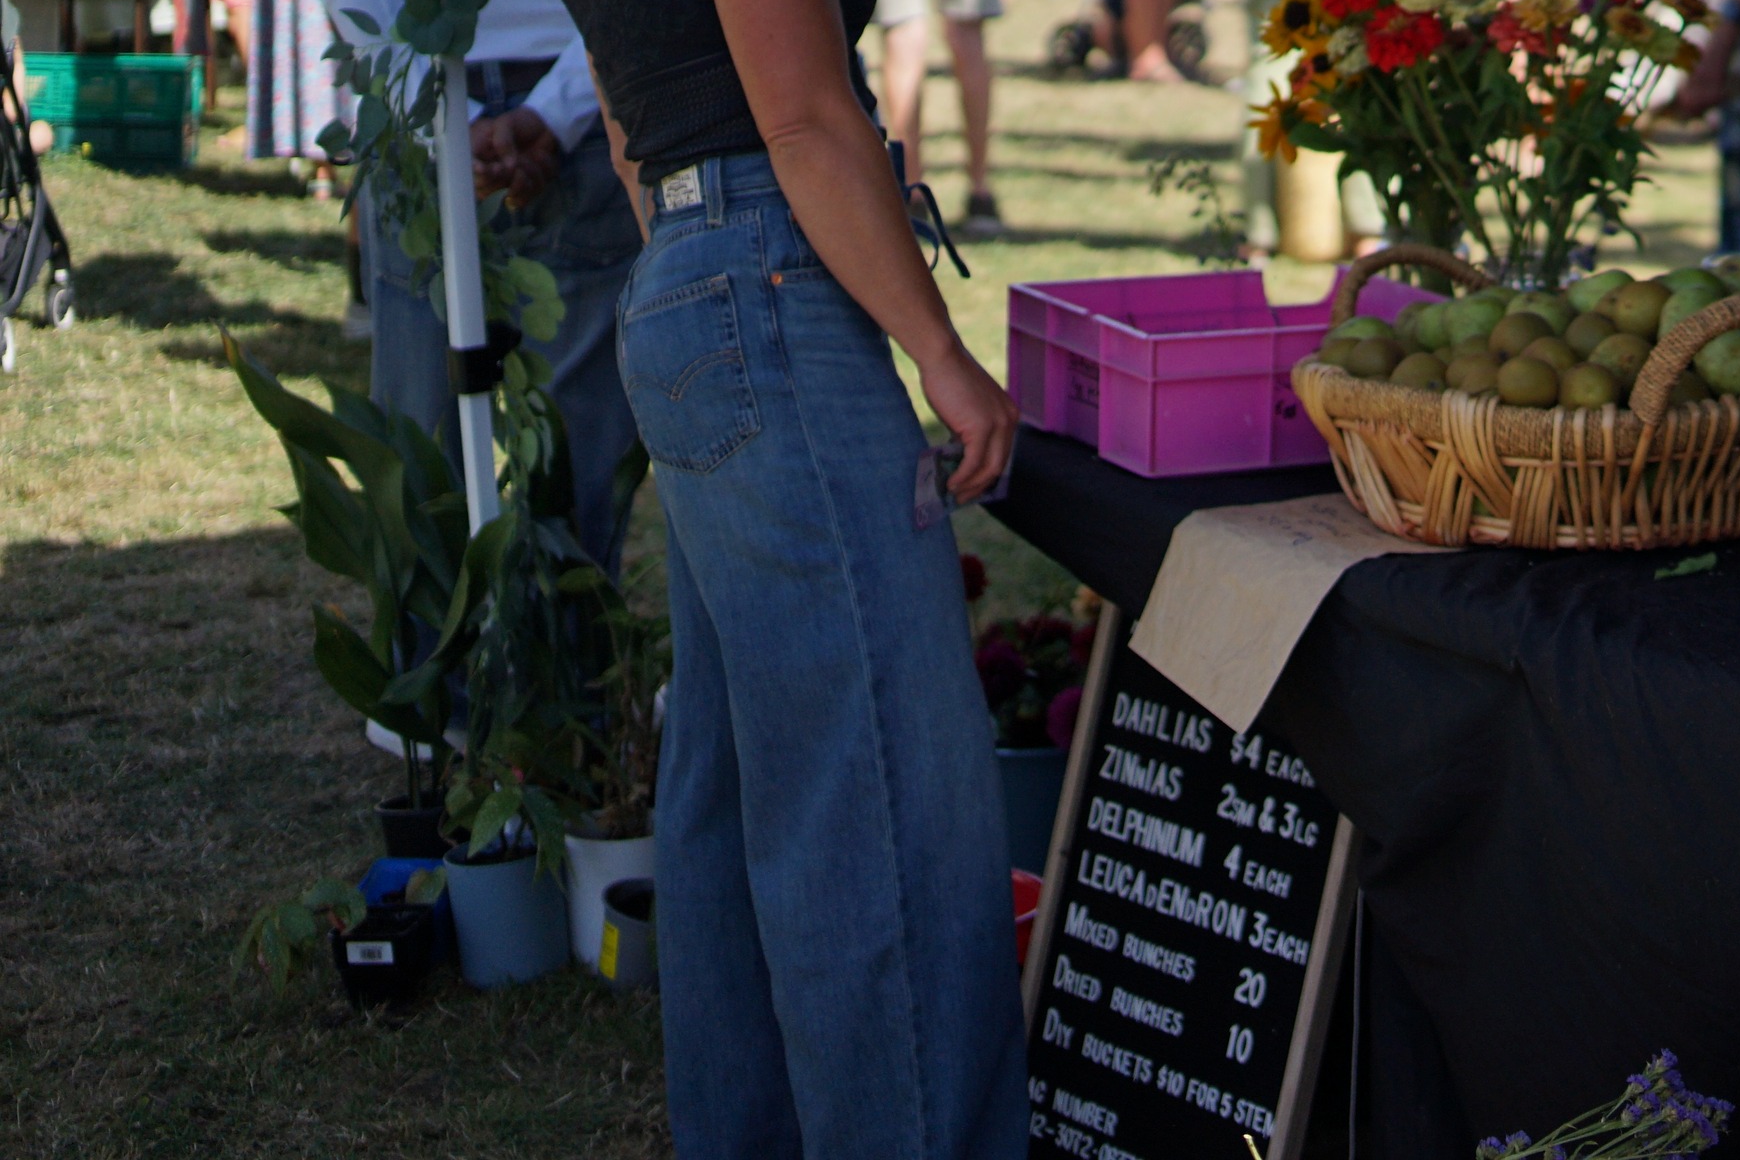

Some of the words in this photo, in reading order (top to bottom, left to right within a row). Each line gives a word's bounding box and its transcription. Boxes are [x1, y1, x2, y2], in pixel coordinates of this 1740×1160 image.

[1112, 691, 1214, 753] DAHLIAS
[1230, 733, 1263, 770] $4
[1087, 796, 1205, 868] DELPHINIUM
[1223, 844, 1243, 880] 4
[1243, 859, 1293, 898] EACH
[1258, 796, 1278, 833] &
[1122, 932, 1197, 982] BUNCHES
[1233, 966, 1268, 1009] 20
[1110, 986, 1184, 1037] BUNCHES
[1225, 1023, 1255, 1064] 10
[1052, 1088, 1119, 1137] NUMBER
[1081, 1033, 1154, 1084] BUCKETS
[1156, 1063, 1186, 1098] $10
[1185, 1077, 1221, 1115] FOR
[1219, 1091, 1234, 1119] 5
